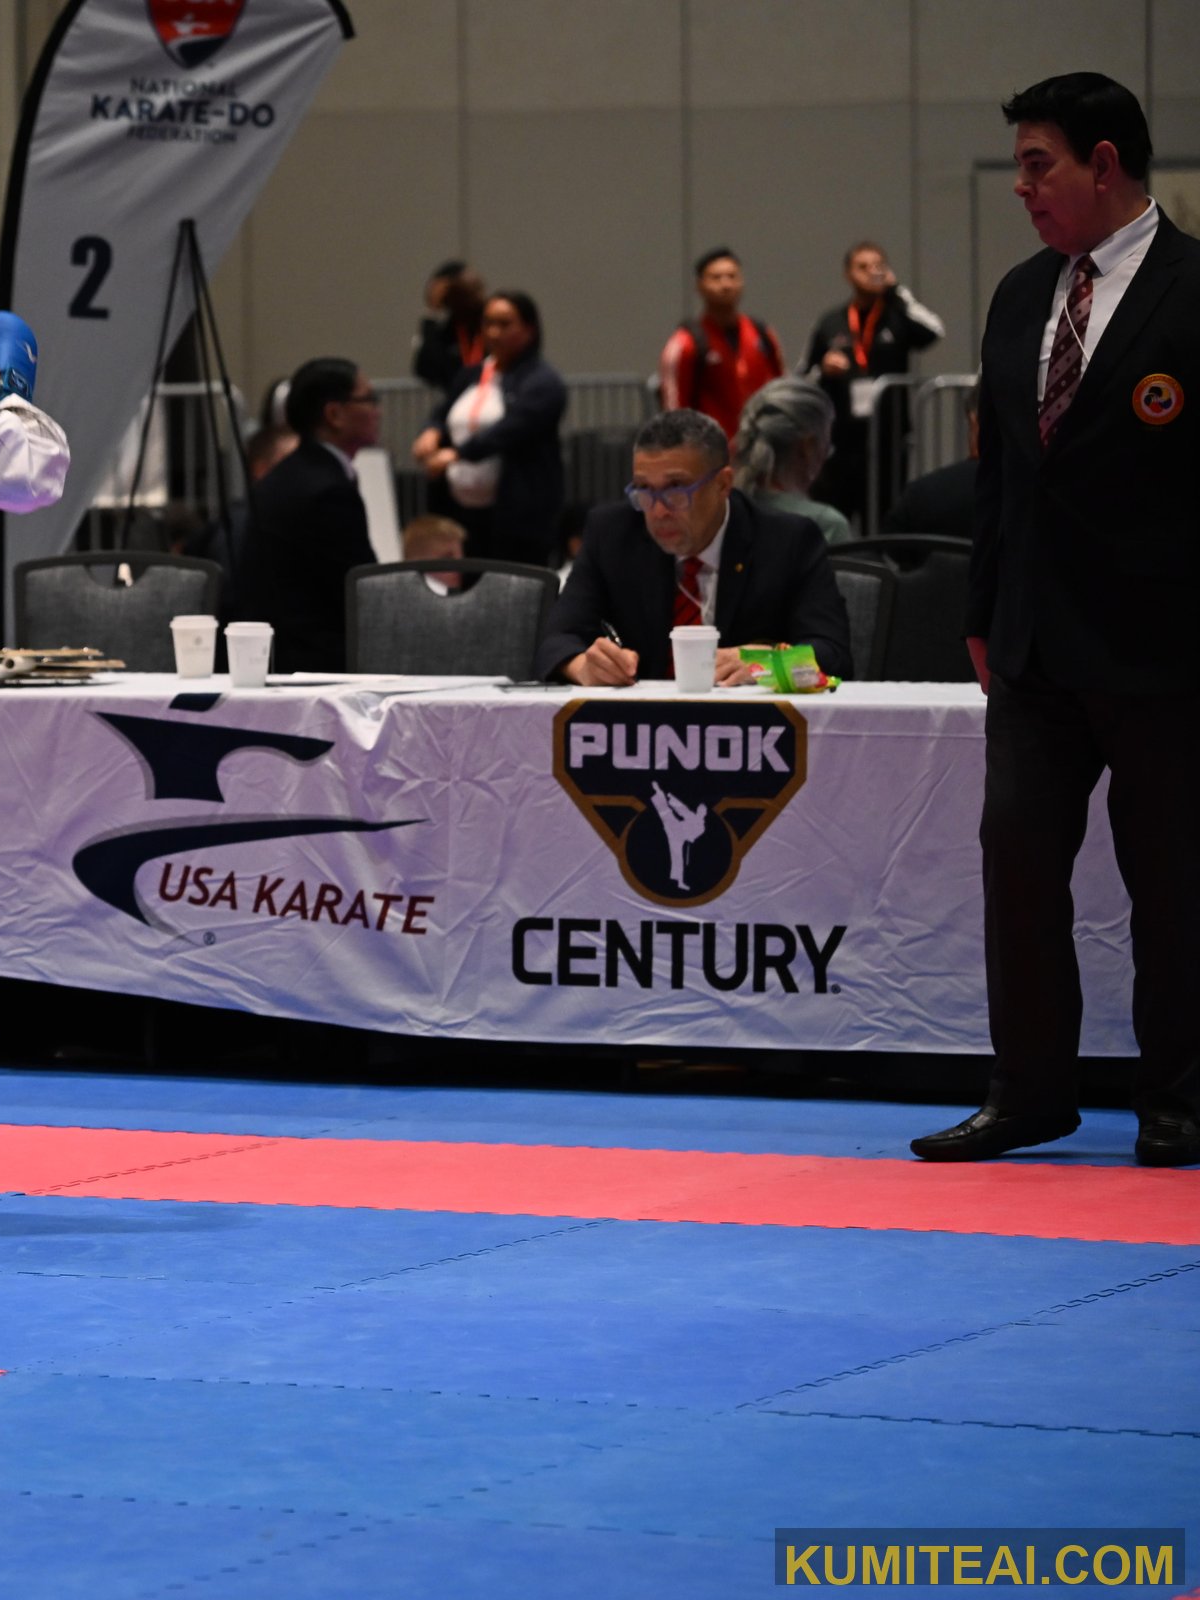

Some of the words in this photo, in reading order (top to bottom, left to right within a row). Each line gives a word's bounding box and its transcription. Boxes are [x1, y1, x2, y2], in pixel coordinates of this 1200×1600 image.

[90, 93, 275, 128] KARATE-DO
[129, 77, 237, 98] NATIONAL
[126, 125, 238, 145] FEDERATION
[68, 234, 113, 320] 2
[569, 722, 791, 773] PUNOK
[157, 862, 239, 911] USA
[251, 873, 436, 936] KARATE
[511, 916, 848, 995] CENTURY
